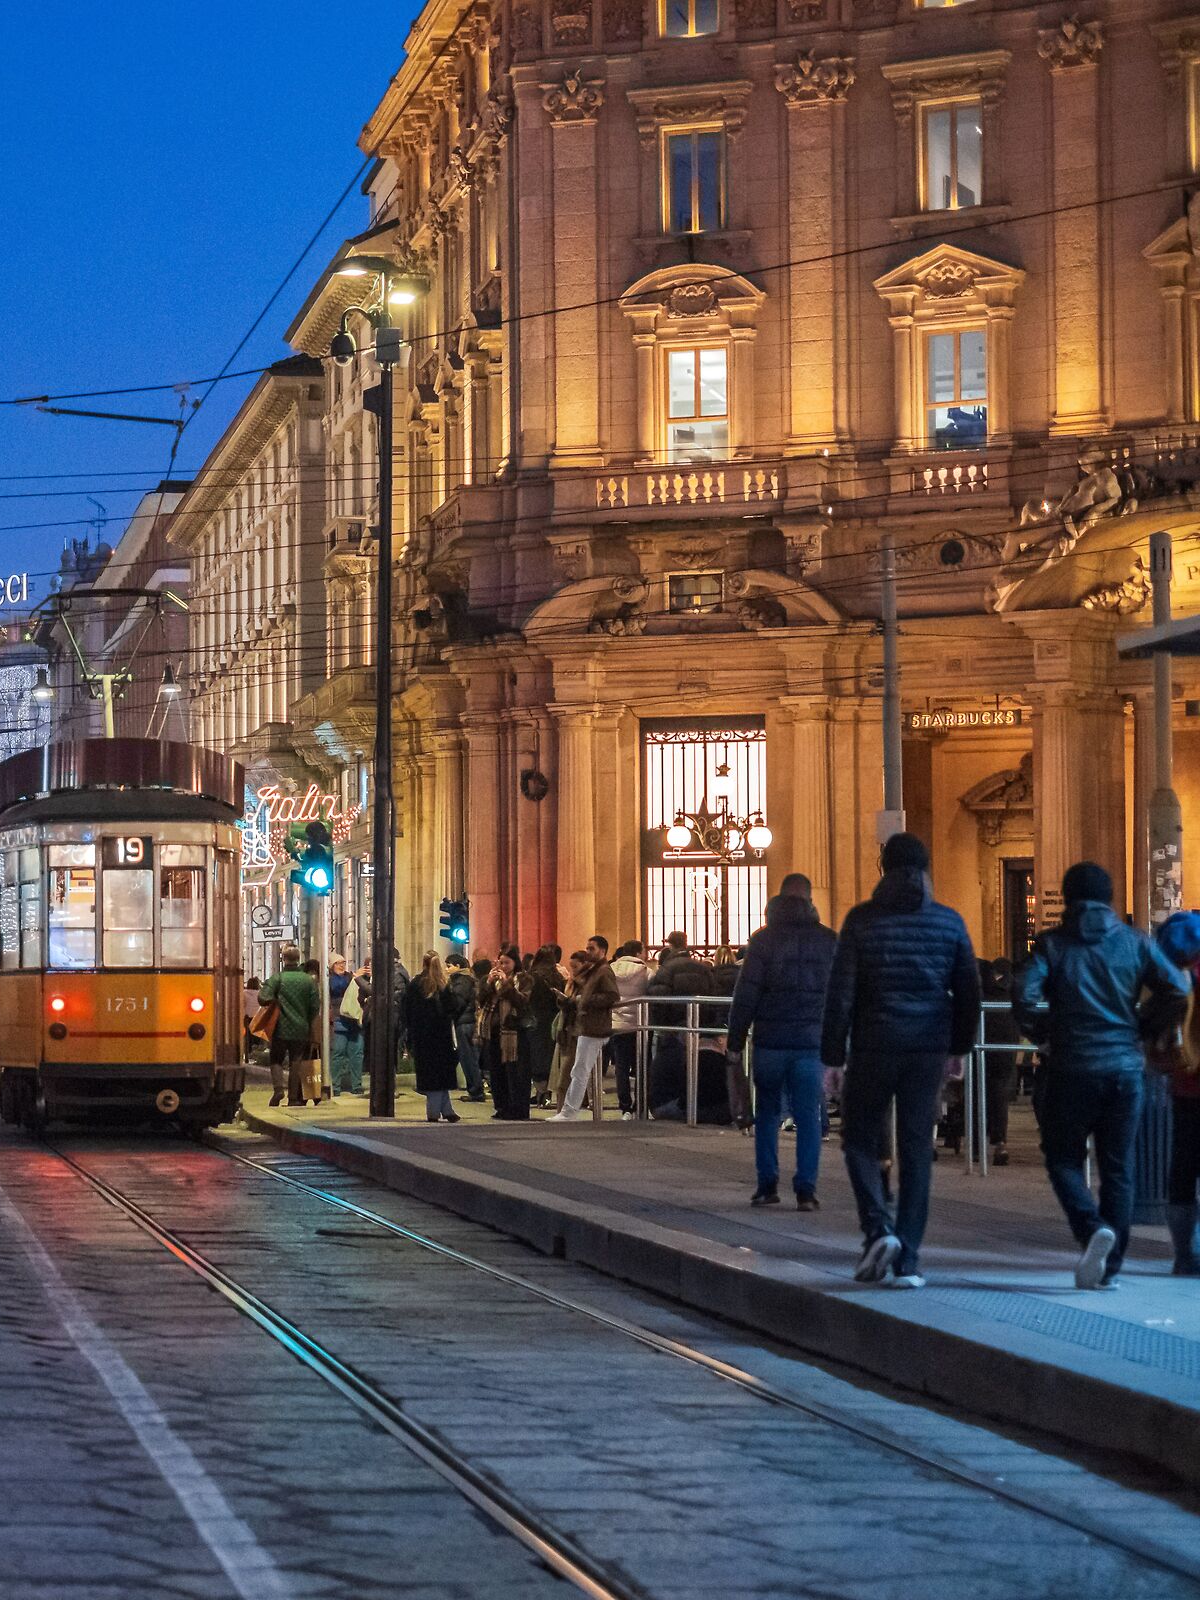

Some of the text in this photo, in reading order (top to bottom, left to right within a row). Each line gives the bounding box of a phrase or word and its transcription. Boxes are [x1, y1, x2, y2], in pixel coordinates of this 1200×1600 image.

[911, 711, 1015, 728] STARBUCKS
[117, 837, 145, 863] 19
[690, 871, 719, 911] R
